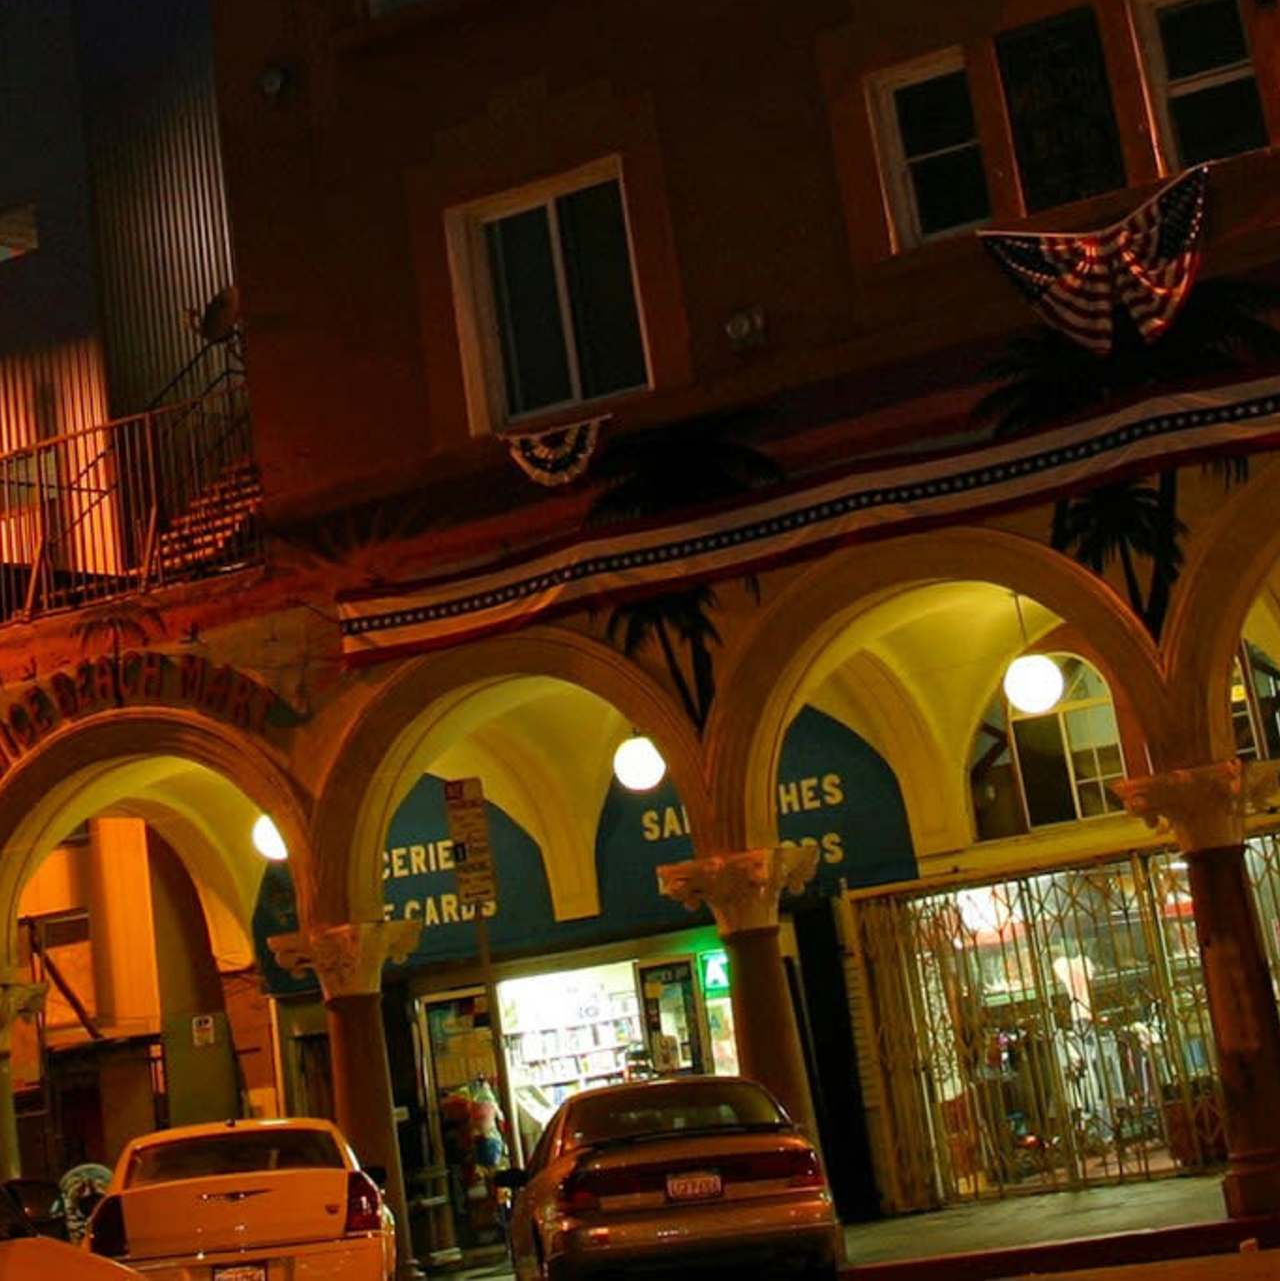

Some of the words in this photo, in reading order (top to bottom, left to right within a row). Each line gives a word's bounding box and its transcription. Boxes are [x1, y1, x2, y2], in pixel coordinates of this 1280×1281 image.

[51, 653, 169, 716] BEACH
[180, 655, 281, 734] MART
[382, 839, 457, 879] ERIE
